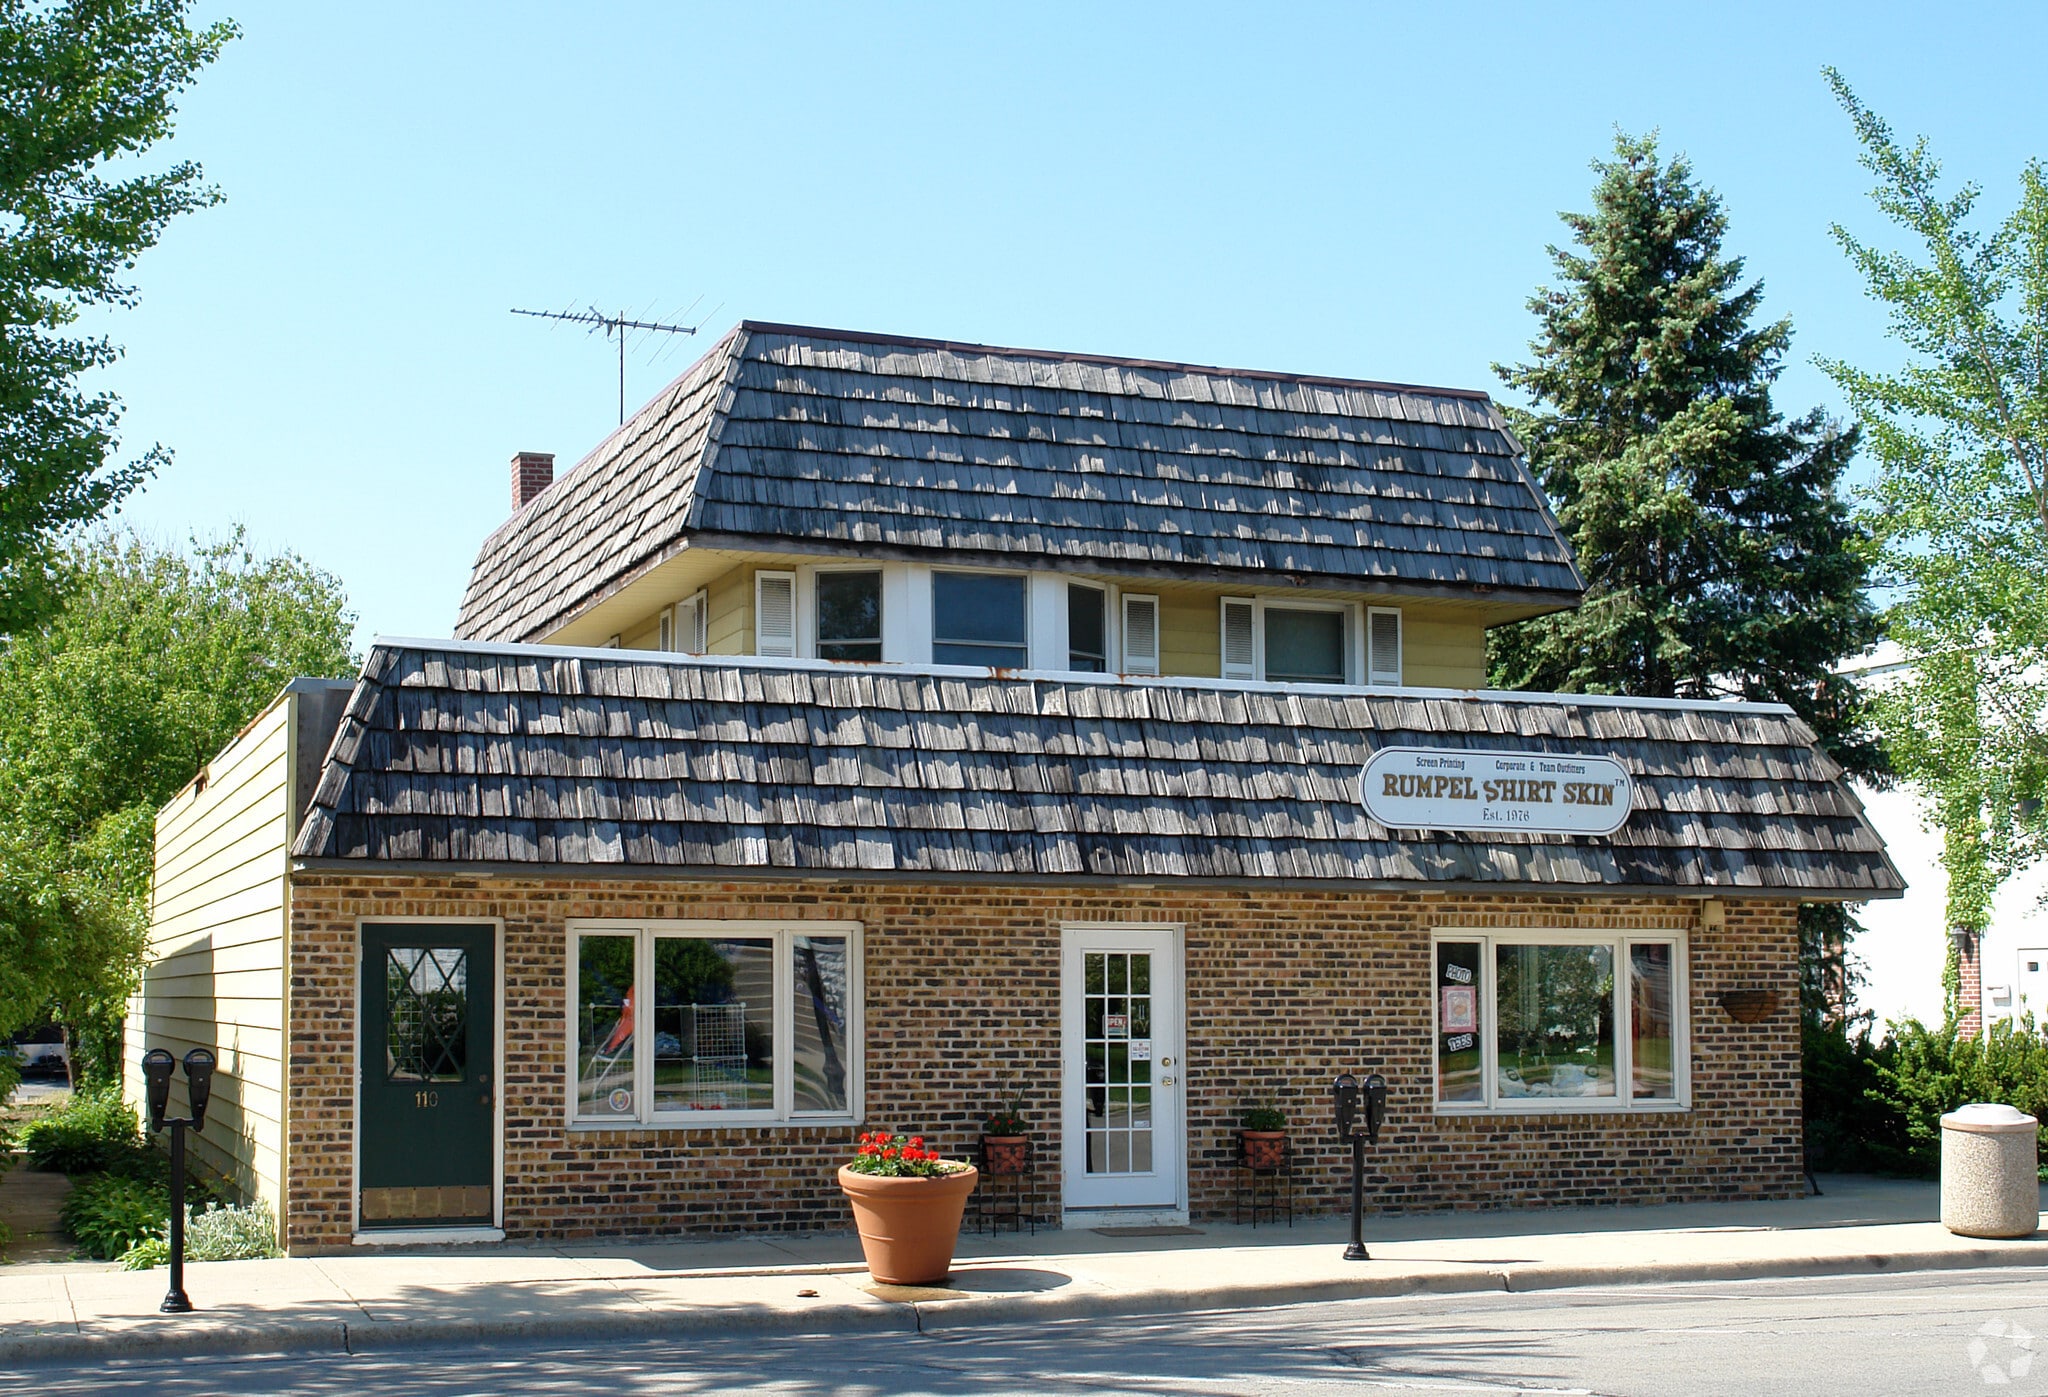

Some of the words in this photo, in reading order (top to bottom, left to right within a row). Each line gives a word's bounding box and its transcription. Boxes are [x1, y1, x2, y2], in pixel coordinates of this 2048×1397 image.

[1416, 757, 1438, 768] Screen
[1440, 758, 1465, 770] Printing
[1496, 760, 1525, 772] Corporate
[1530, 763, 1535, 771] &
[1539, 762, 1555, 773] Team
[1557, 763, 1586, 774] Outfitters
[1382, 774, 1478, 800] RUMPEL
[1483, 779, 1556, 803] SHIRT
[1562, 782, 1615, 806] SKIN
[1483, 808, 1502, 821] Est.
[1507, 810, 1530, 821] 1976
[1446, 964, 1471, 983] PHOTO
[1448, 1034, 1472, 1051] TEES
[415, 1090, 439, 1108] 110
